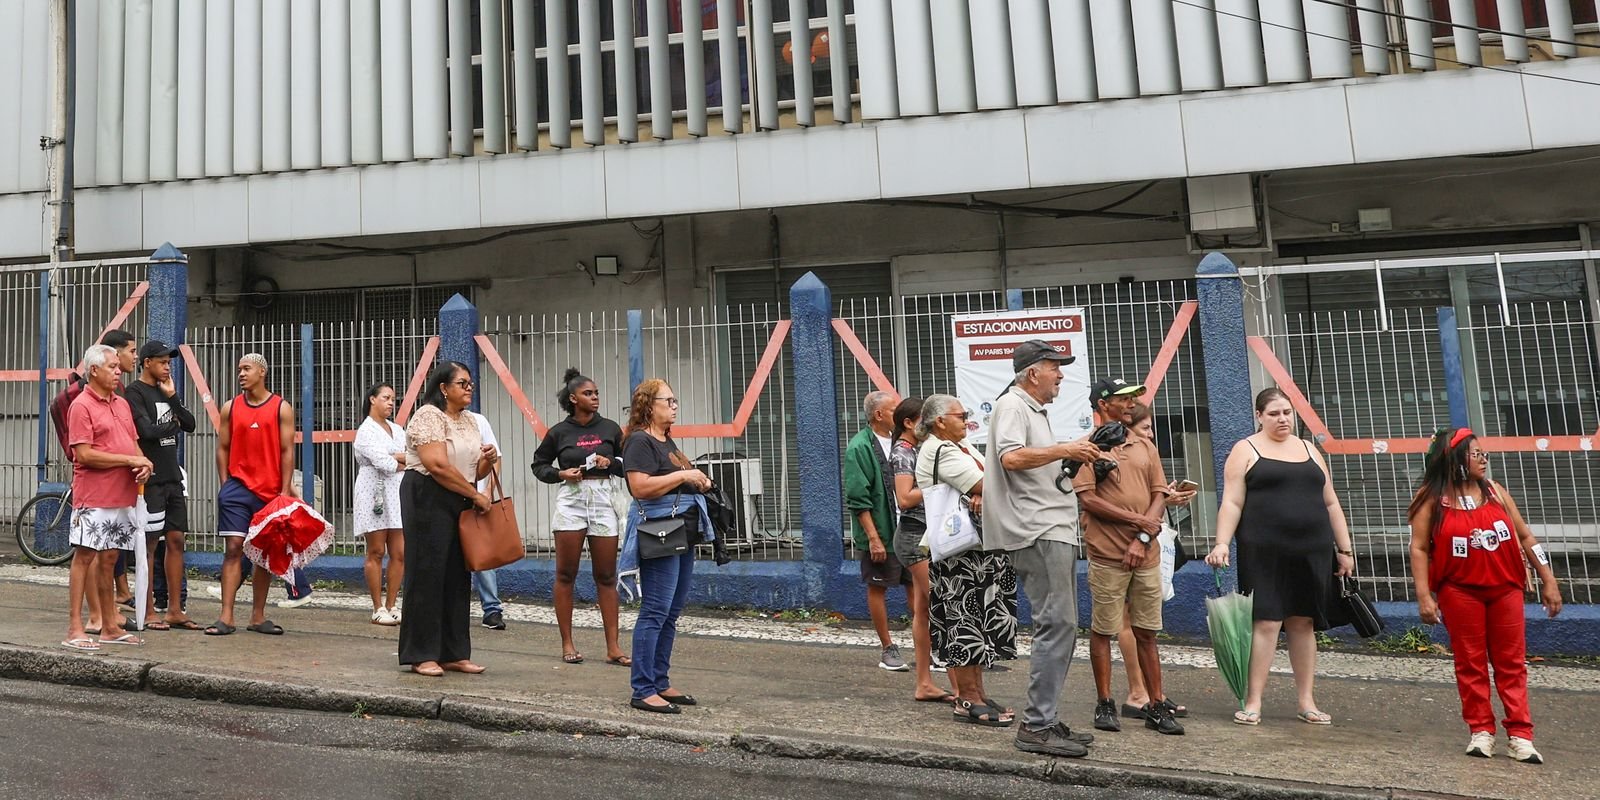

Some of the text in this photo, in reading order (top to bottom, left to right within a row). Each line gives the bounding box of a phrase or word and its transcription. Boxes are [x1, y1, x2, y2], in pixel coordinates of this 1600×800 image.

[963, 319, 1073, 334] ESTACIONAMENTO
[1499, 530, 1509, 538] 13
[1486, 535, 1497, 546] 13
[1455, 546, 1466, 554] 13
